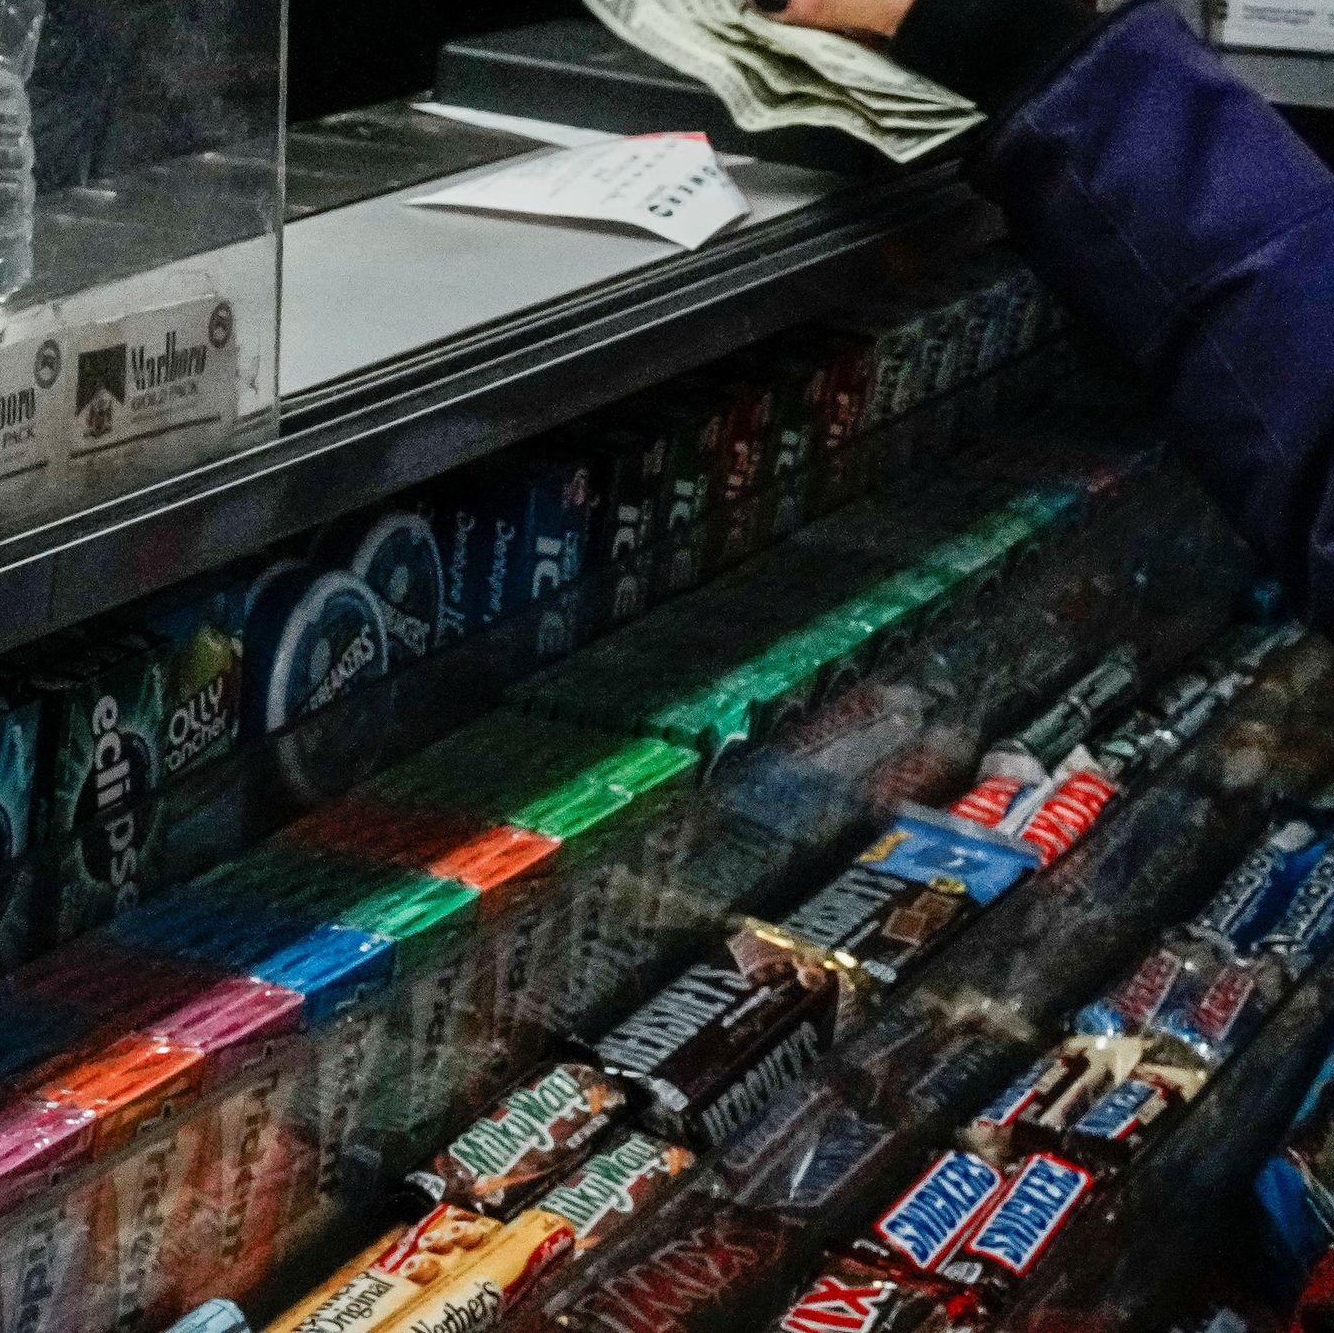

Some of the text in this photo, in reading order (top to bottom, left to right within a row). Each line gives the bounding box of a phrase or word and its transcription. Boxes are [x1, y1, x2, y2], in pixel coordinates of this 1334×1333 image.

[131, 331, 207, 391] Marlboro
[885, 1153, 998, 1258] SNICKERS
[975, 1158, 1087, 1266] SNICKERS
